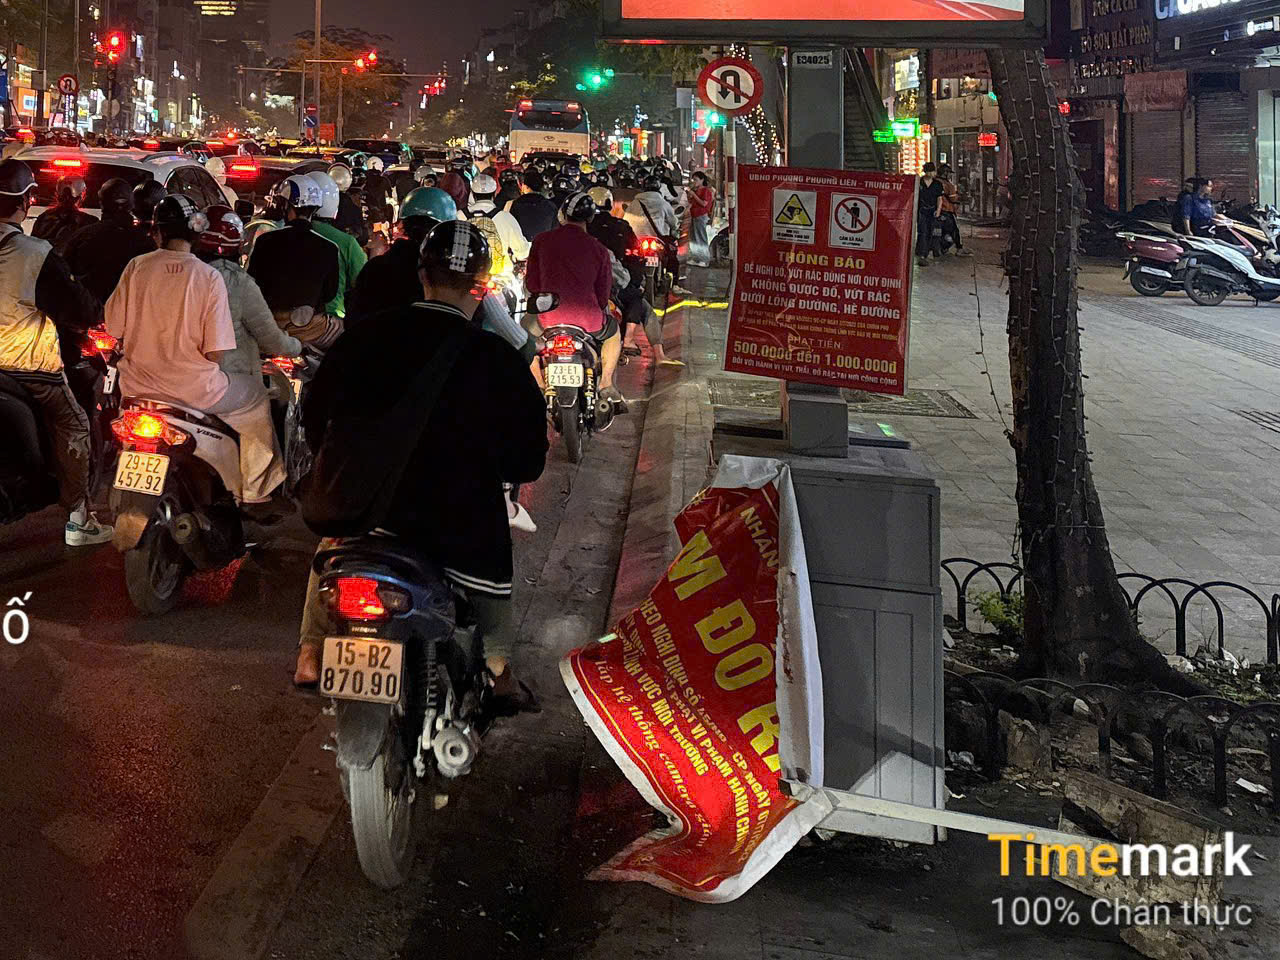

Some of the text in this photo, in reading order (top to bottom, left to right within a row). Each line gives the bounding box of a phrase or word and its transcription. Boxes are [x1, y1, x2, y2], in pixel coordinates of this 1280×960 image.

[796, 54, 830, 65] E34025
[777, 250, 866, 270] THÔNG BÁO
[752, 278, 891, 303] KHÔNG ĐƯỢC VỨT RÁC
[805, 269, 902, 290] RÁC QUY ĐỊNH
[740, 291, 901, 320] DƯỚI HÈ ĐƯỜNG
[796, 350, 898, 375] đến 1.000.000đ
[124, 455, 162, 474] 29-E2
[117, 470, 162, 494] 457.92
[335, 642, 392, 670] 15-B2
[323, 668, 399, 698] 870.90
[636, 671, 710, 777] VỰC MÔI TRƯỜNG
[612, 686, 634, 706] hệ
[628, 703, 660, 752] thống
[658, 753, 697, 810] camera
[699, 736, 733, 778] PHẠM
[745, 771, 771, 809] NGÀY
